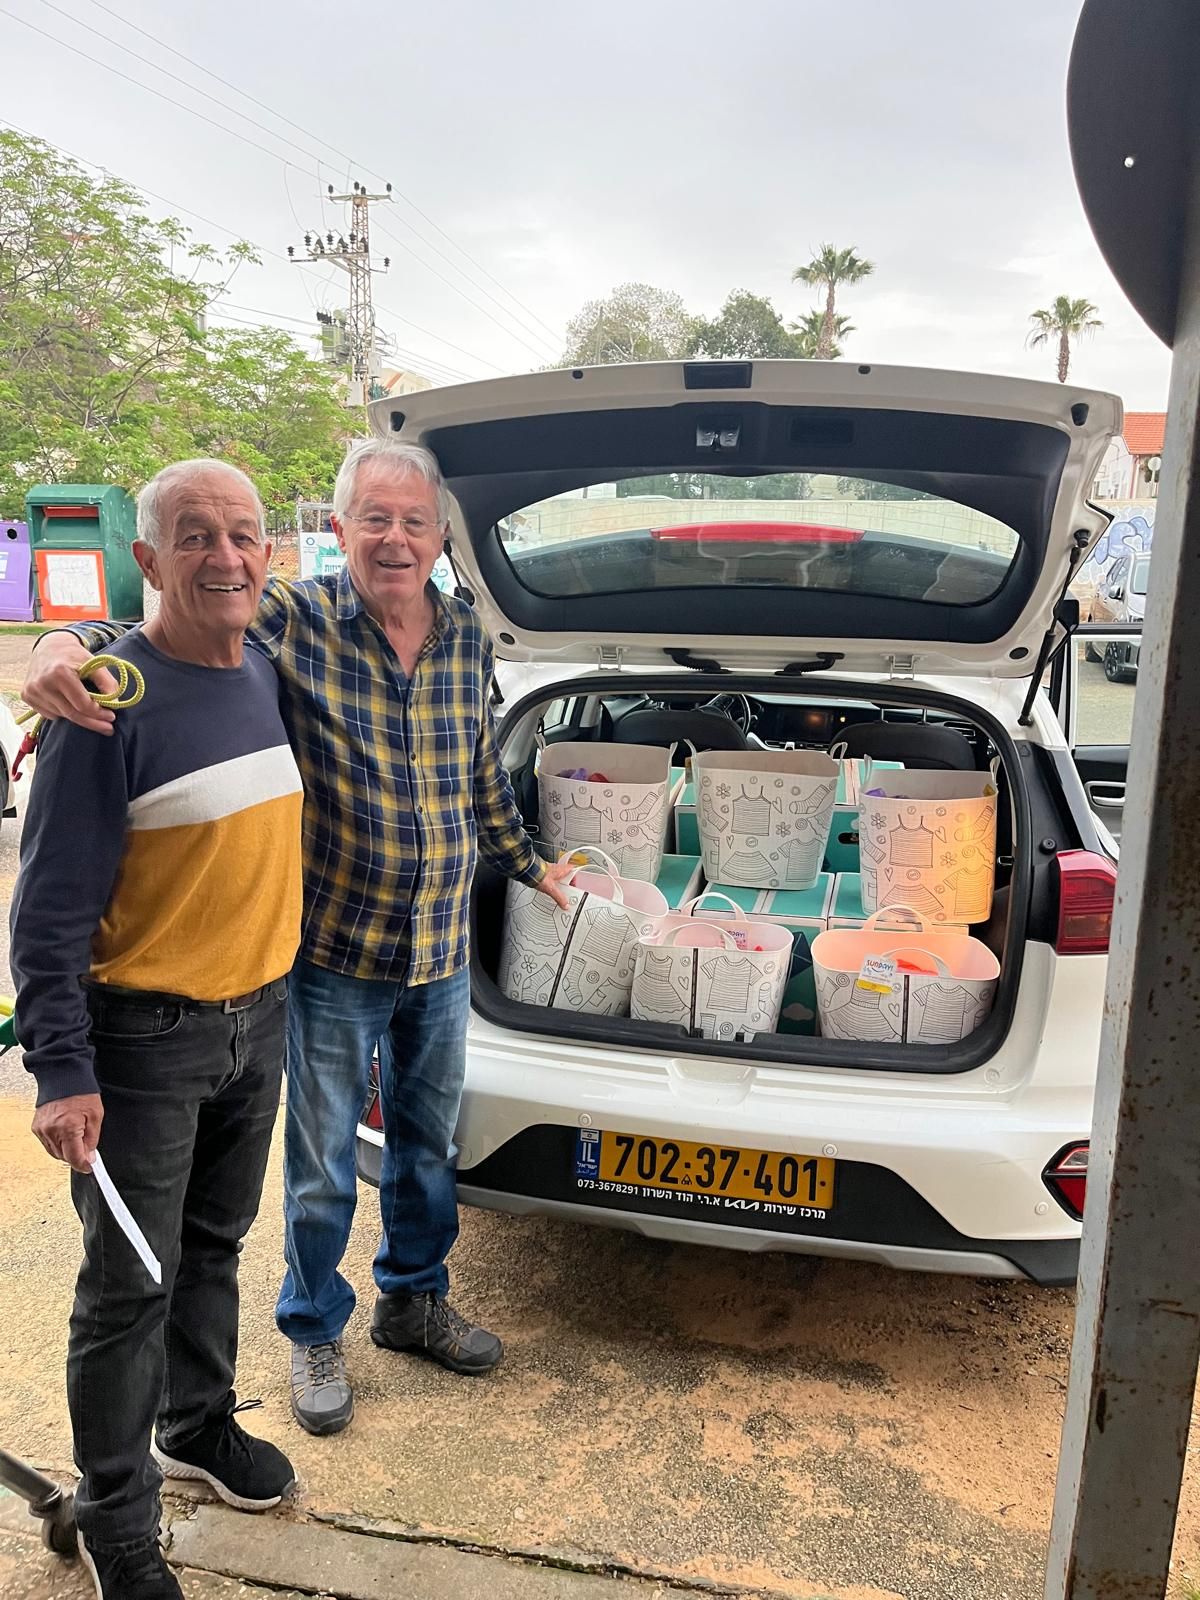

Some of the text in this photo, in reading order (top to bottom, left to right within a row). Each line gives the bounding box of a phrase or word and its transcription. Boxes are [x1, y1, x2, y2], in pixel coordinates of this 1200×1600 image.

[324, 564, 344, 574] ריזות
[582, 1142, 596, 1163] IL
[577, 1178, 639, 1195] 073-3678291
[642, 1186, 672, 1200] השרון
[675, 1190, 693, 1202] הוד
[763, 1202, 797, 1215] שירות
[800, 1207, 826, 1220] מרכז
